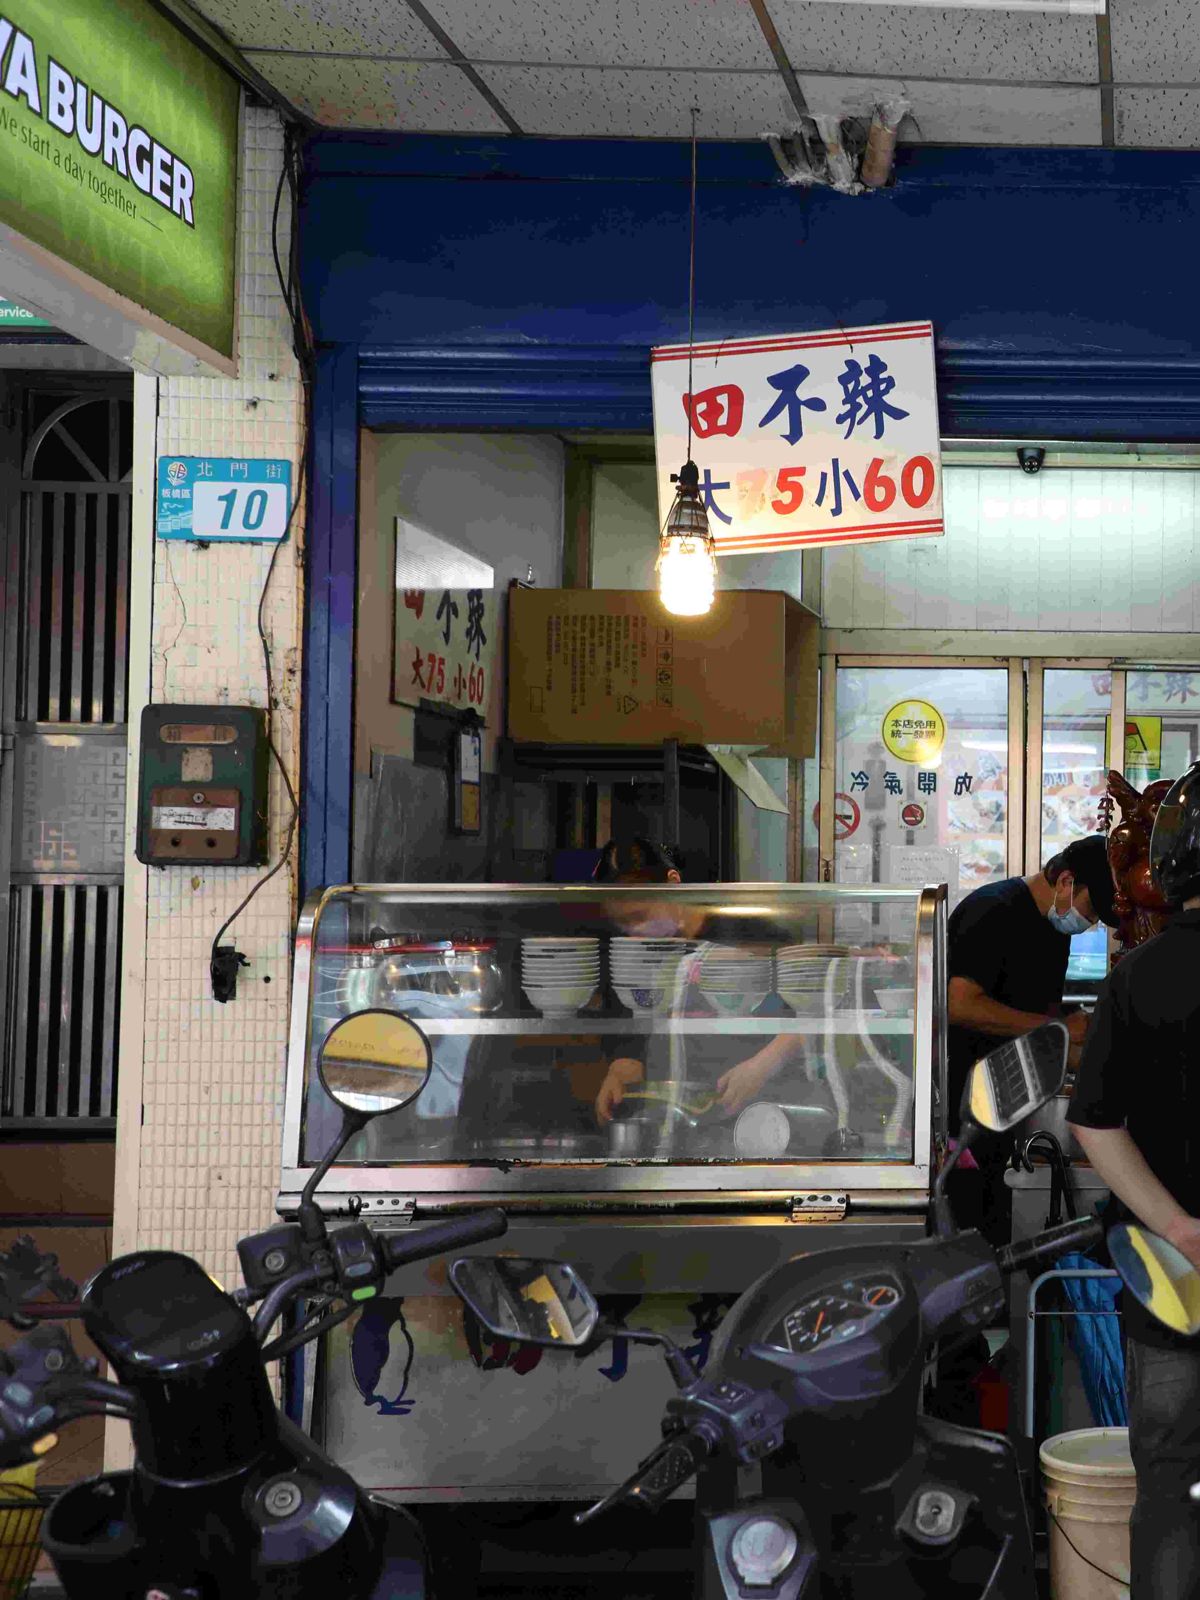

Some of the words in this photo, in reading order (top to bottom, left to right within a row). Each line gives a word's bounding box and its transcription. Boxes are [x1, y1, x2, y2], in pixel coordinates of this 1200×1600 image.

[48, 56, 195, 228] BURGER
[21, 125, 51, 161] start
[53, 148, 62, 169] a
[64, 153, 86, 187] day
[88, 169, 137, 219] together
[682, 354, 911, 446] 田不辣
[197, 461, 282, 479] 北門街
[217, 488, 269, 531] 10
[891, 719, 937, 729] 本店免用
[850, 771, 973, 796] 冷氣開放
